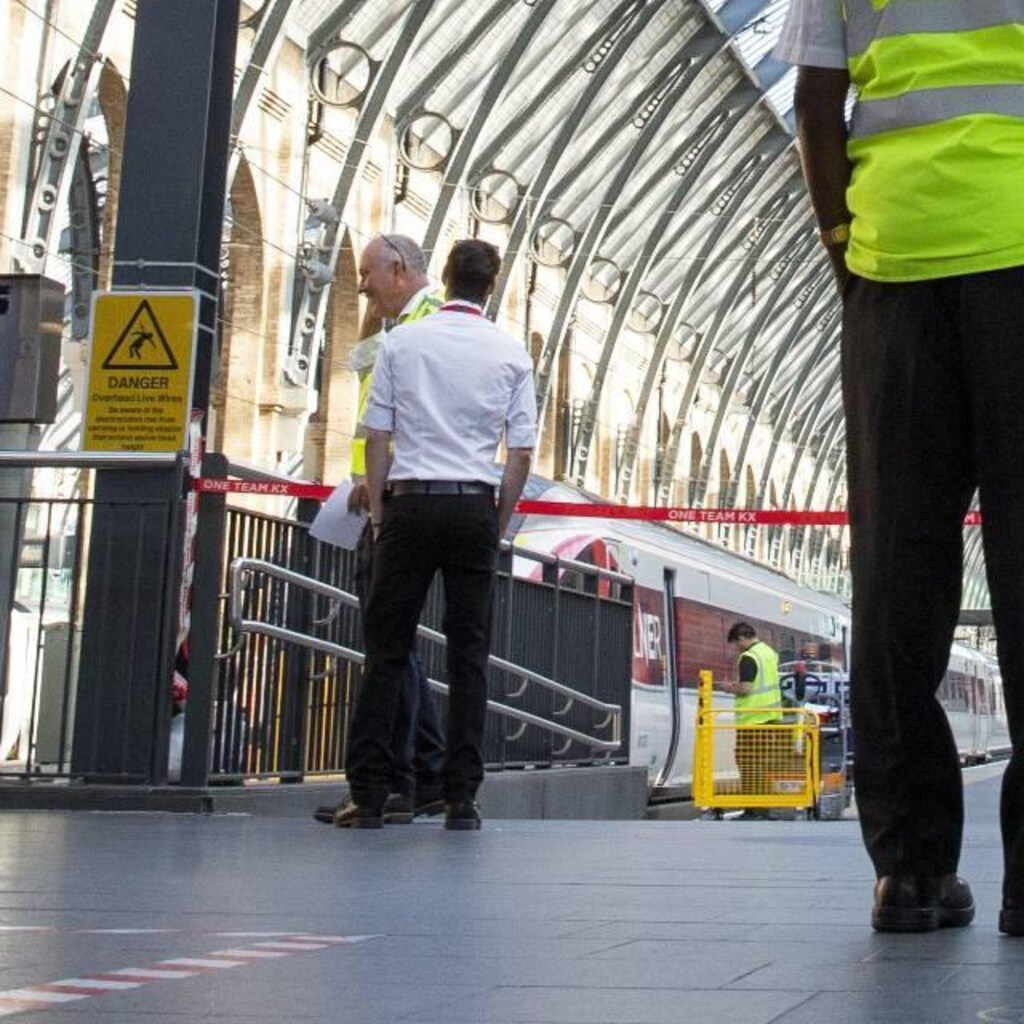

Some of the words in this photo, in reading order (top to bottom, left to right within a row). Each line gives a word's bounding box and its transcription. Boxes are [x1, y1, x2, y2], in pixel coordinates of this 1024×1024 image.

[107, 376, 169, 389] DANGER
[203, 479, 231, 491] ONE
[235, 482, 268, 493] TEAM
[271, 484, 290, 494] KX
[668, 509, 695, 521] ONE
[699, 510, 735, 522] TEAM
[738, 511, 757, 523] KX
[632, 602, 662, 666] LNER
